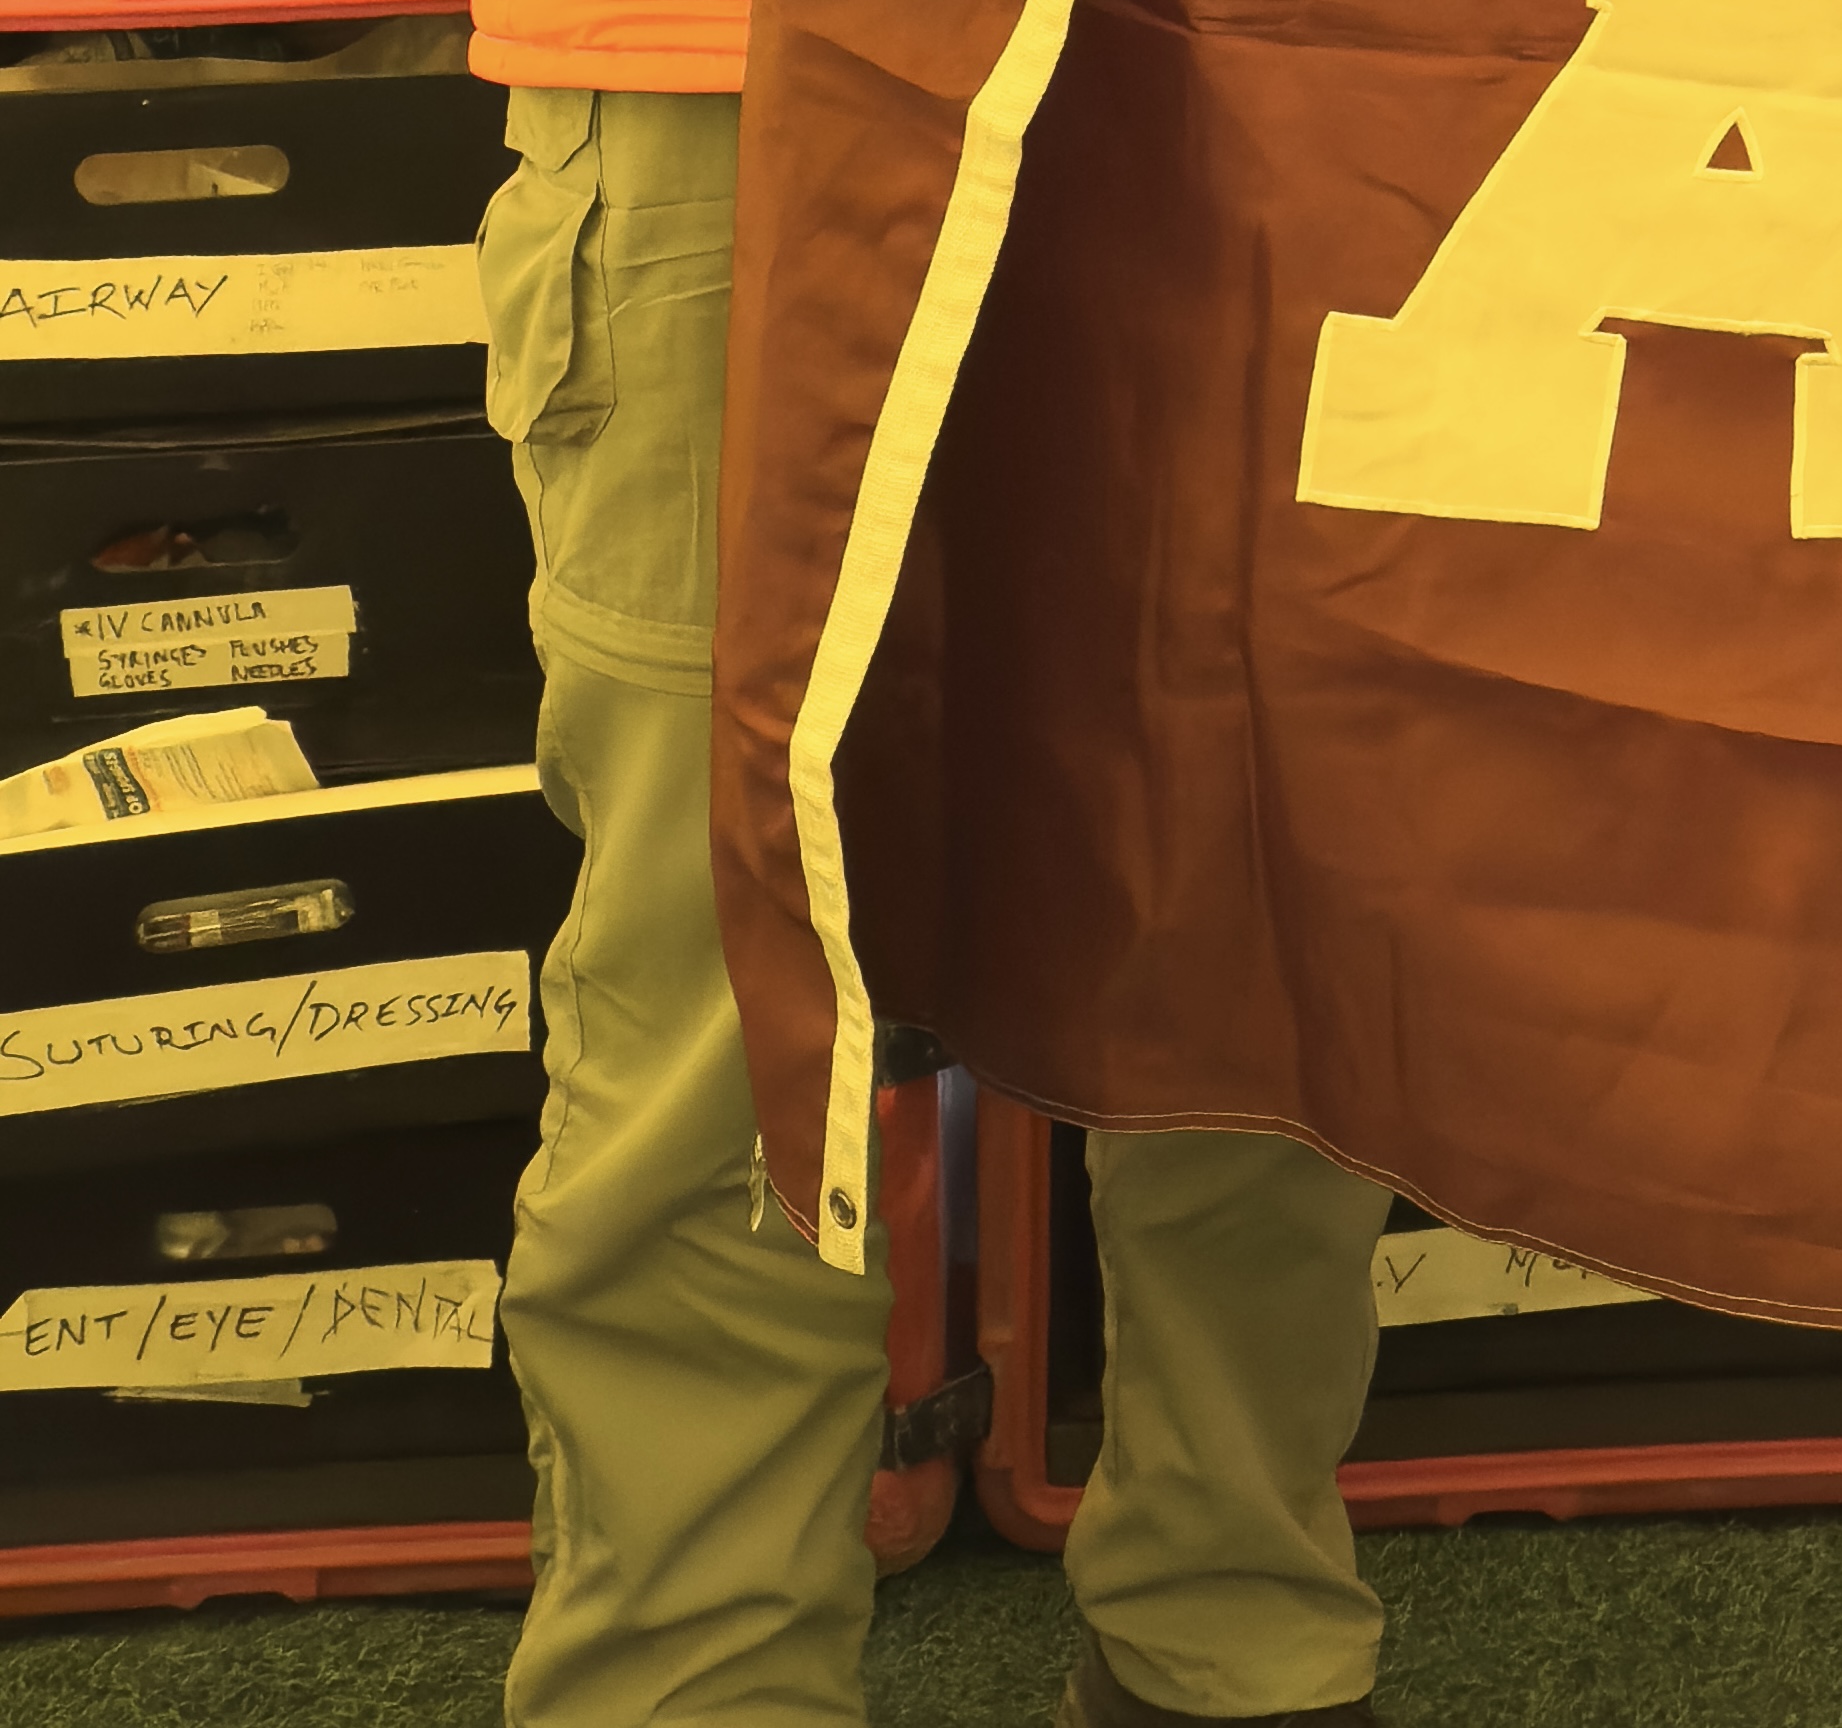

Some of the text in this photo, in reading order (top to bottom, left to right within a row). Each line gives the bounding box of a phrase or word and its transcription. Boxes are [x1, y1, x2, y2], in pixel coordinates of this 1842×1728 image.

[0, 274, 229, 327] AIRWAY
[141, 600, 267, 632] CANNULA
[99, 668, 173, 690] GLOVES
